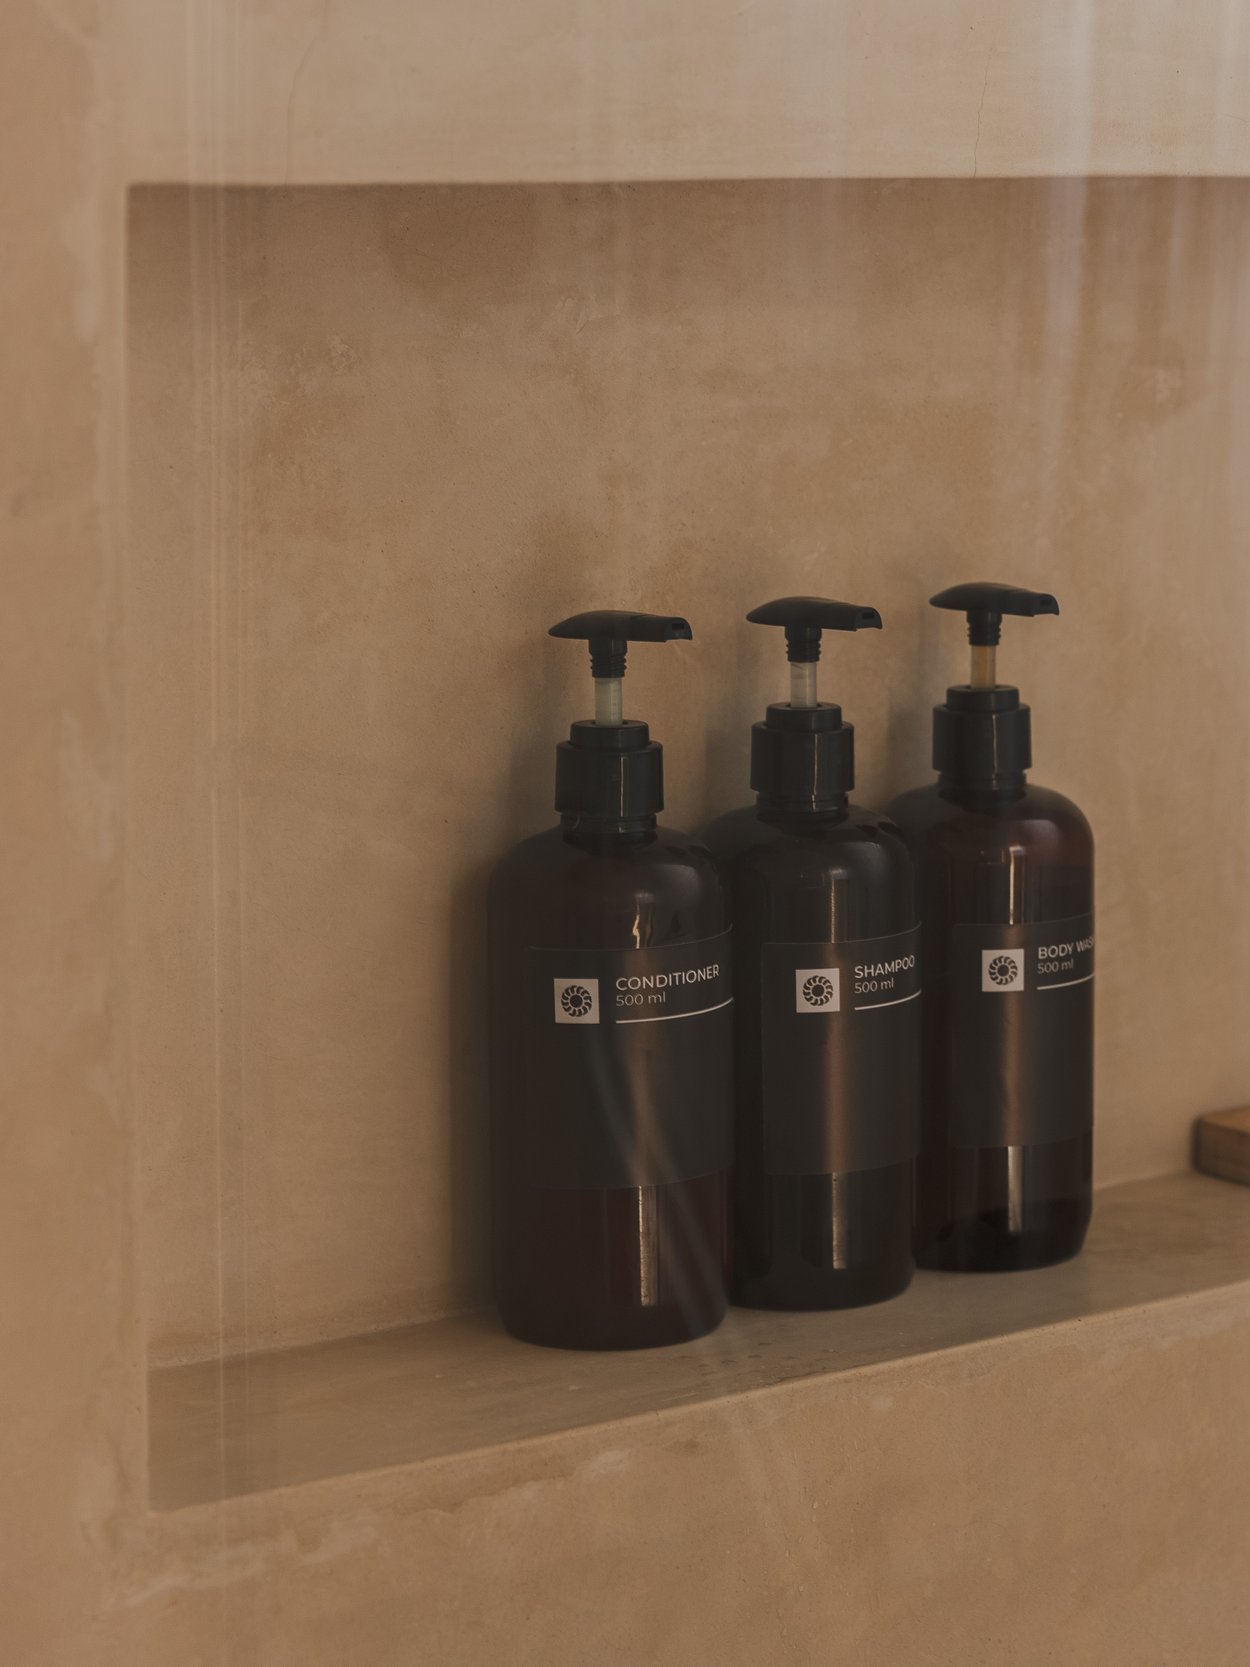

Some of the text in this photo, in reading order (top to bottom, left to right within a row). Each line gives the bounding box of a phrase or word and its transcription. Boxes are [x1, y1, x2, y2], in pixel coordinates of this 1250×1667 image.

[1038, 942, 1074, 959] BODY
[854, 954, 915, 979] SHAMPOO
[1037, 958, 1074, 974] 500 ml
[615, 963, 720, 991] CONDITIONER
[854, 977, 894, 994] 500 ml
[615, 991, 666, 1007] 500 ml
